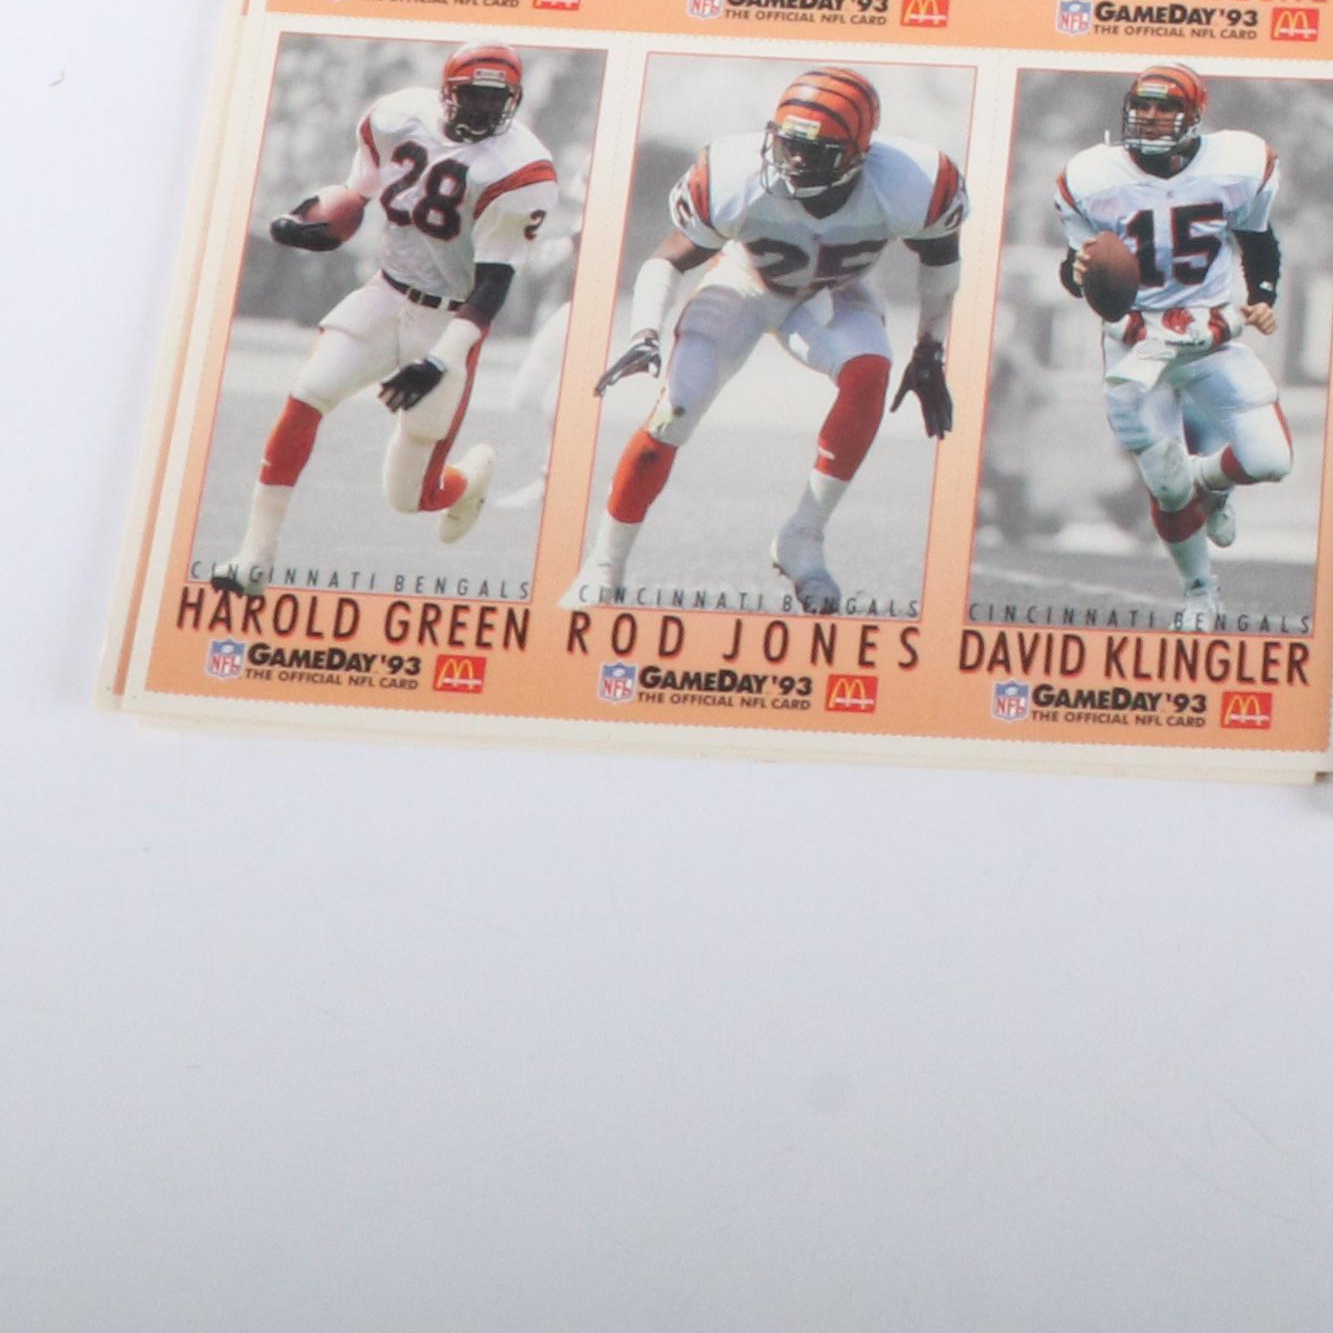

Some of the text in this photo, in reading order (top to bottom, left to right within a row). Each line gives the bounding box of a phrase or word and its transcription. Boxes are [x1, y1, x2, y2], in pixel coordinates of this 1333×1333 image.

[724, 7, 888, 26] THE OFFICIAL NFL CARD
[378, 140, 471, 241] 28
[1126, 202, 1224, 288] 15
[176, 585, 532, 652] HAROLD GREEN
[566, 609, 922, 671] ROD JONES
[958, 627, 1311, 687] DAVID KLINGLER
[1031, 710, 1206, 728] THE OFFICIAL NFL CARD
